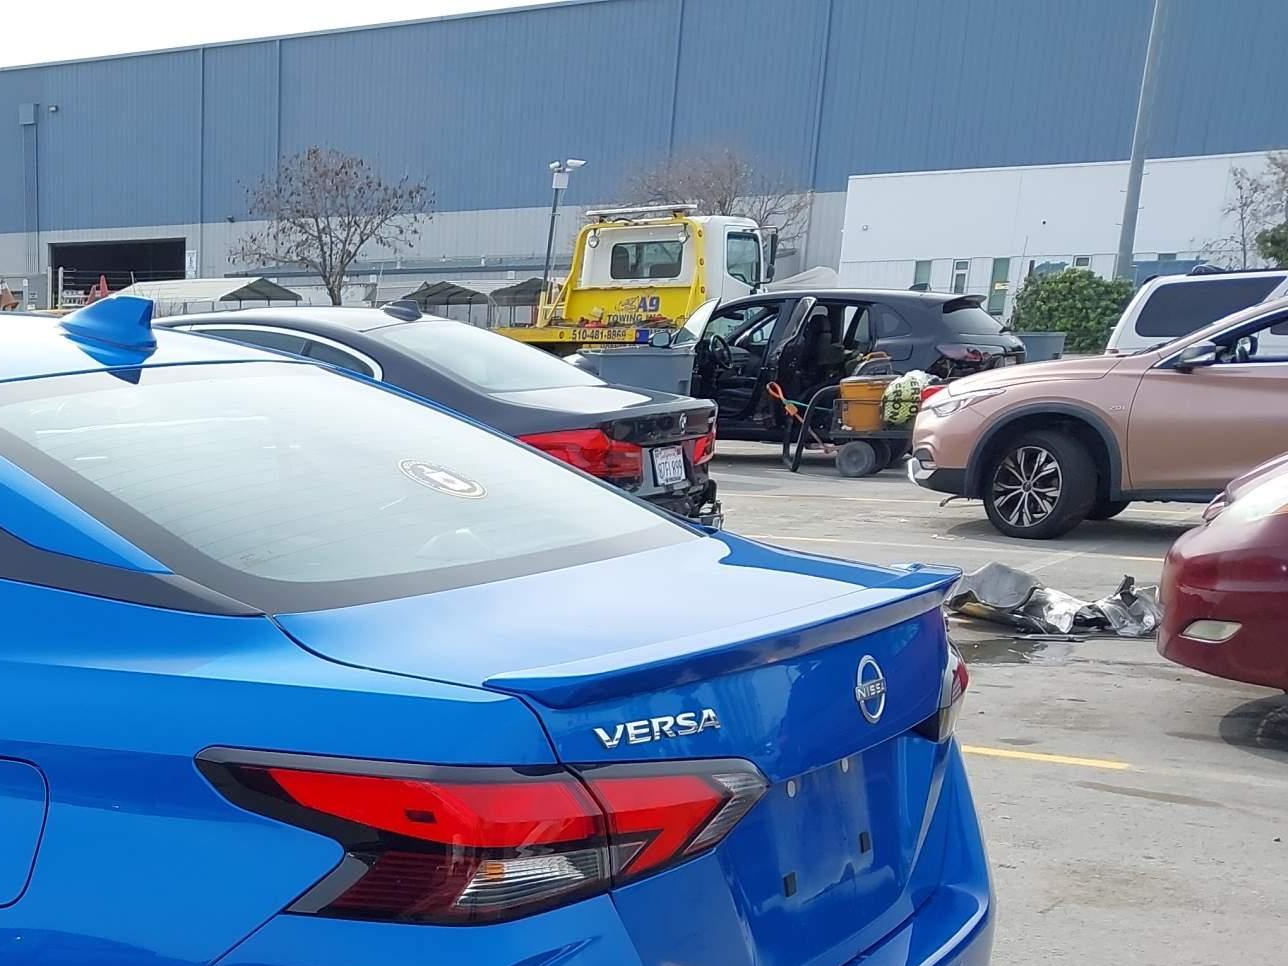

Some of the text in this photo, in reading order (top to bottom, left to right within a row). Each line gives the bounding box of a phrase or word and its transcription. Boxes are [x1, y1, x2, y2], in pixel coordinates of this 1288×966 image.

[637, 295, 661, 313] A9
[607, 313, 643, 324] TOWING
[593, 708, 721, 749] VERSA
